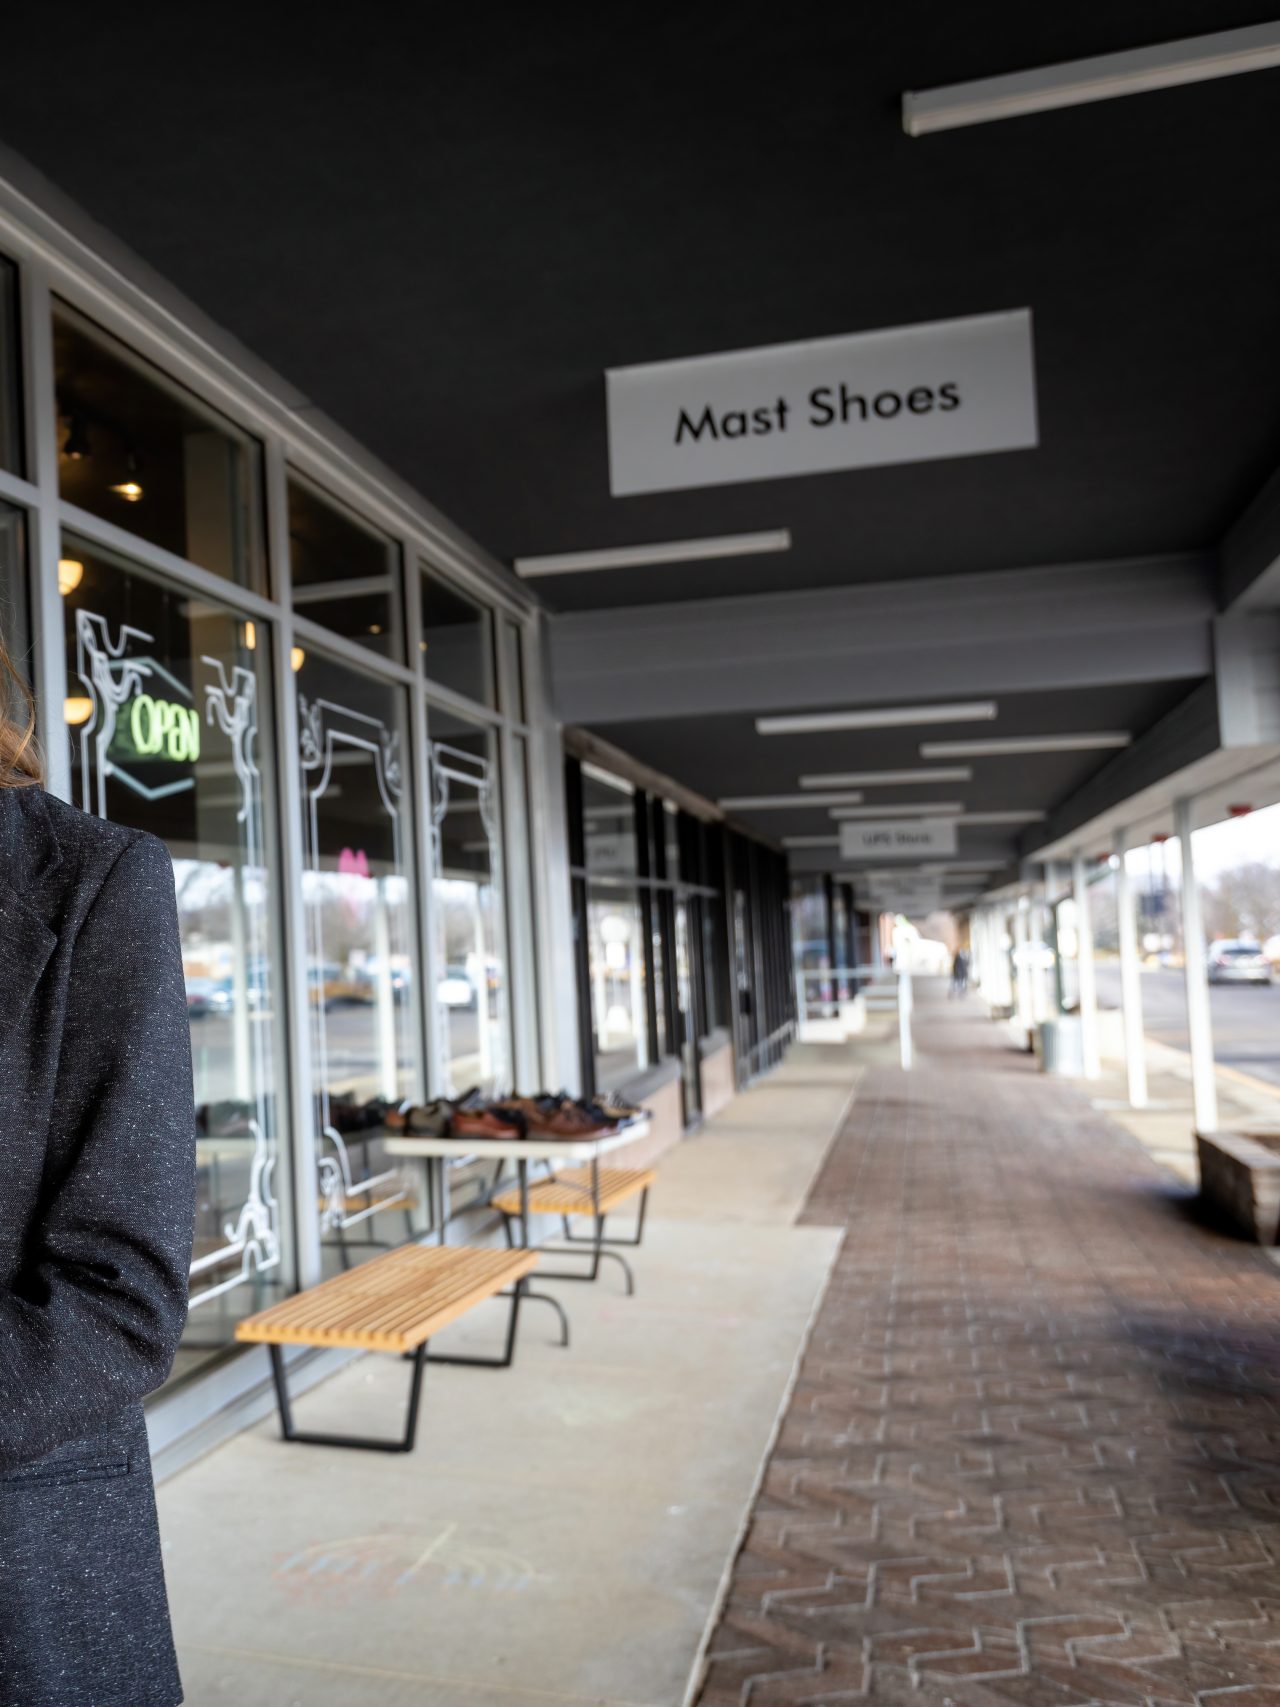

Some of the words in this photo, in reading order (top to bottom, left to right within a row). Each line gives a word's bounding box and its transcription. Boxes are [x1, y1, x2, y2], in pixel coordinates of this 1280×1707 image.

[674, 397, 789, 445] Mast
[809, 382, 962, 429] Shoes
[130, 694, 200, 762] OPEN
